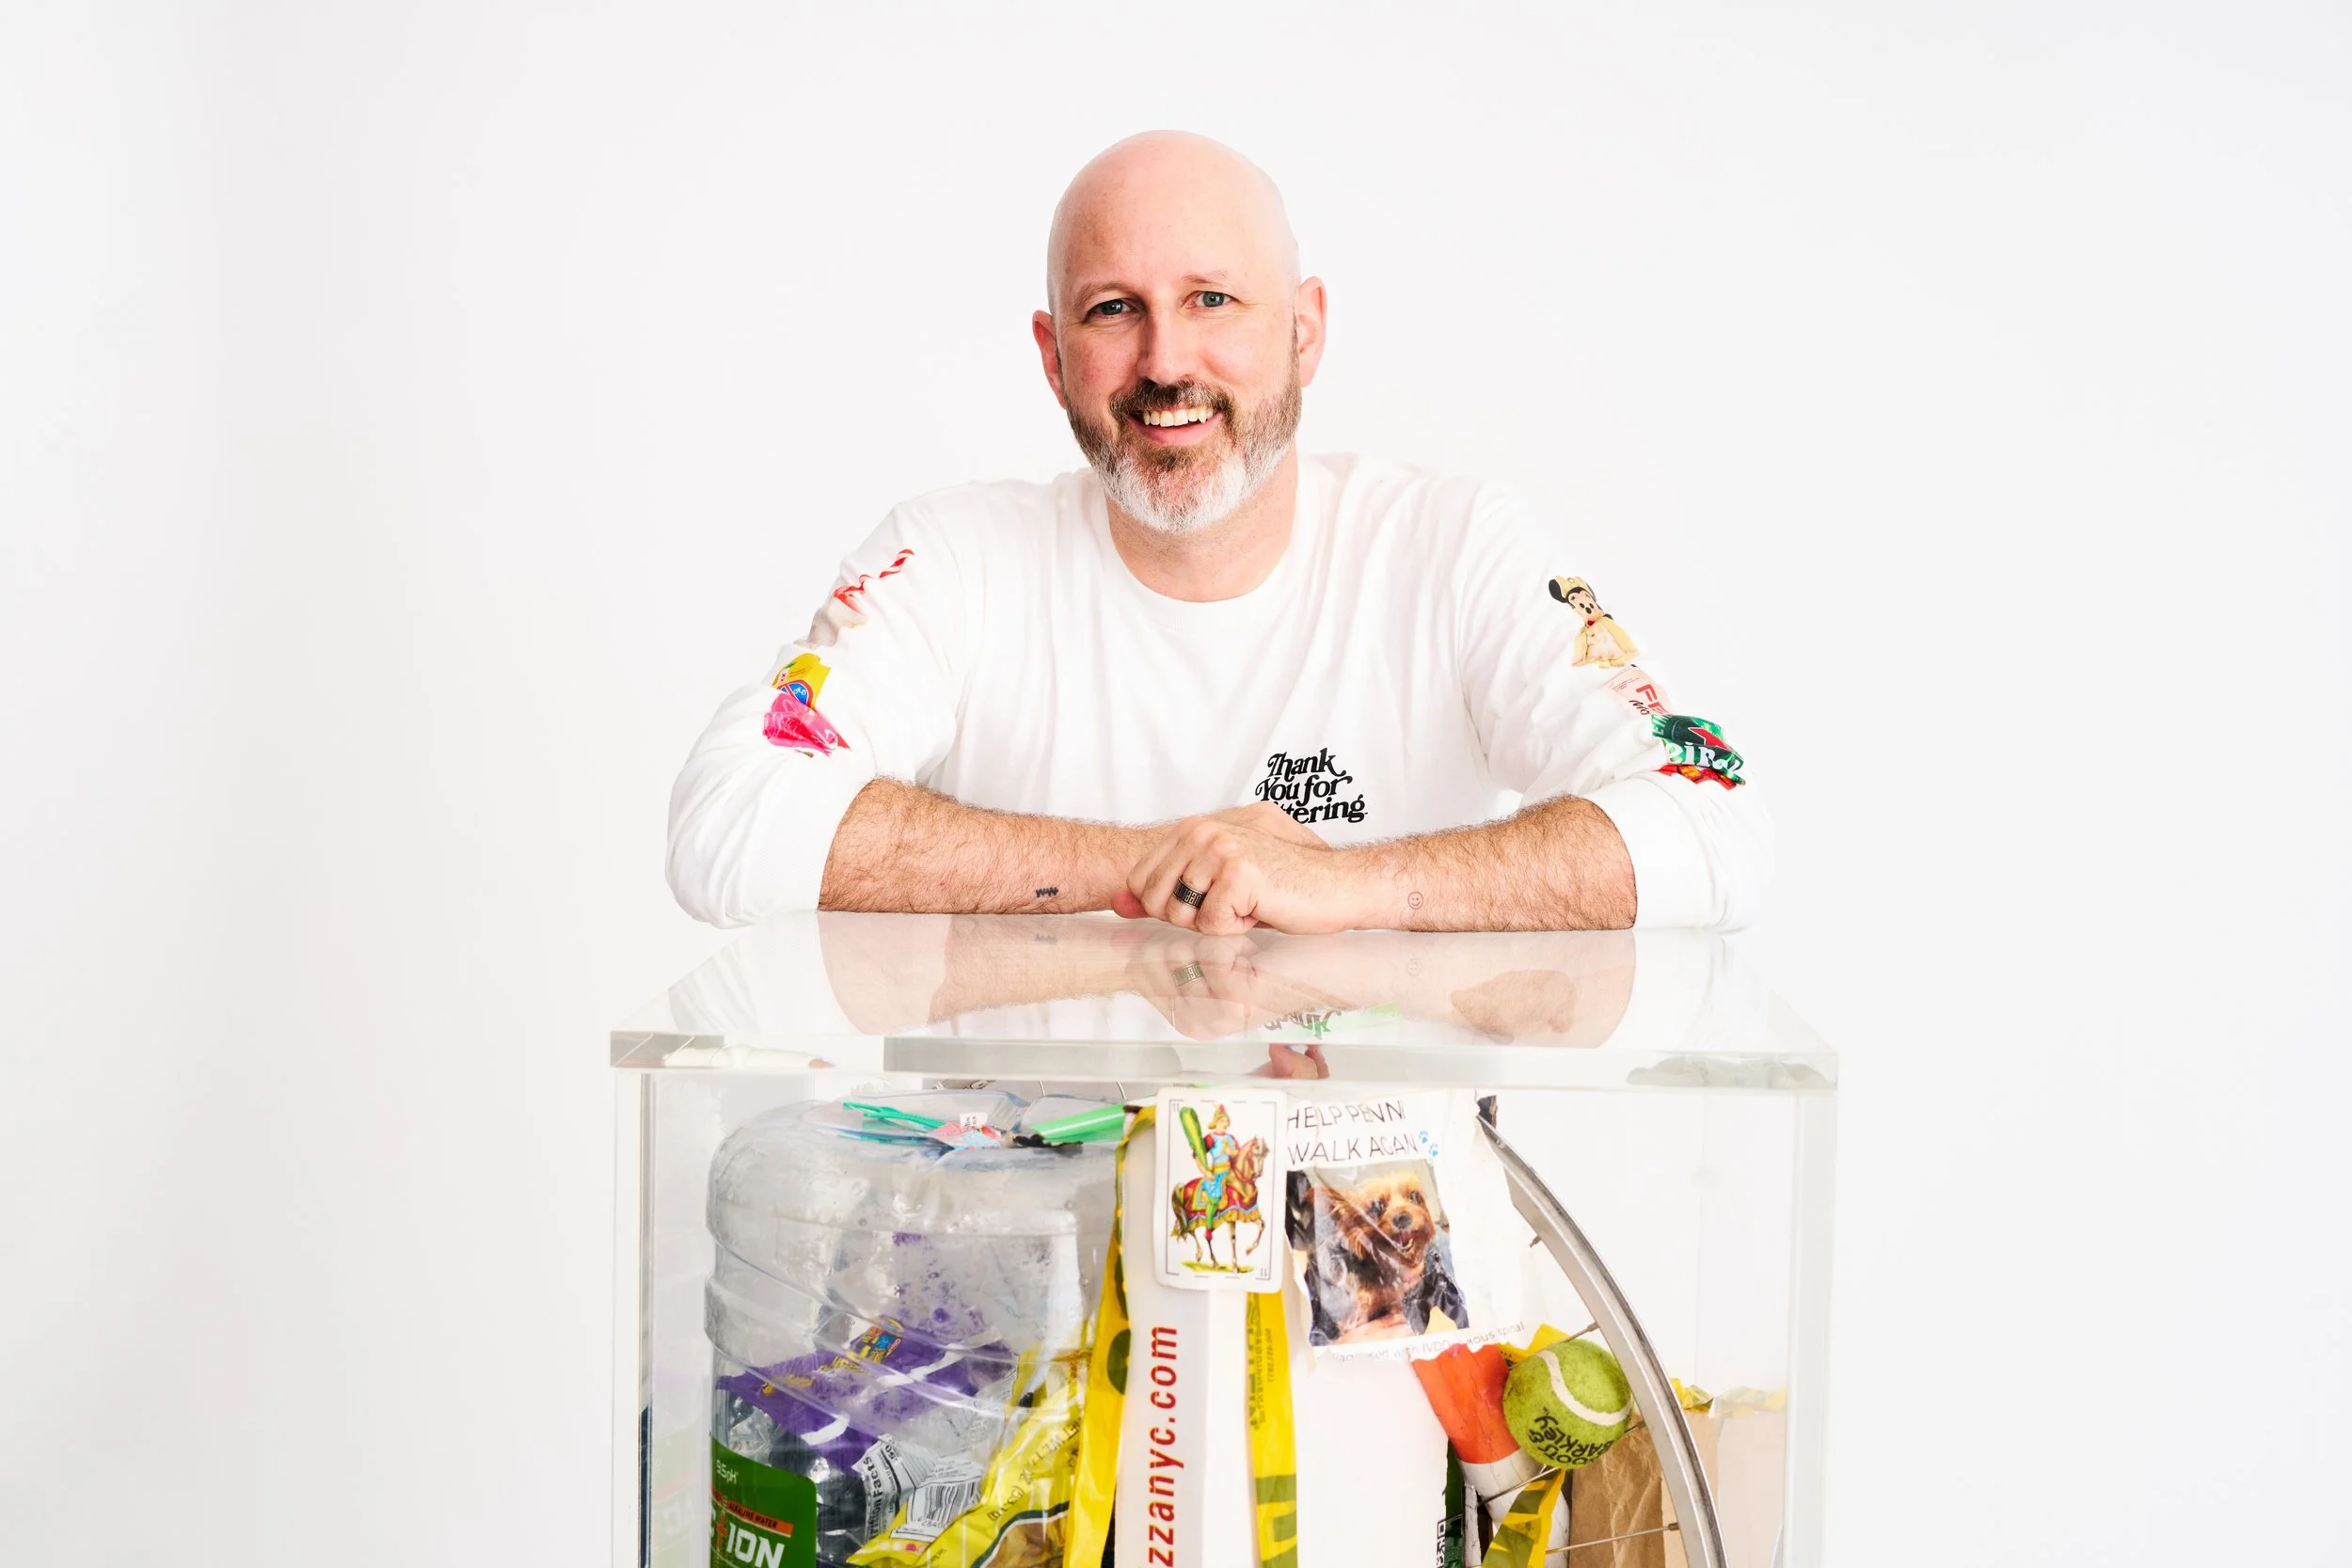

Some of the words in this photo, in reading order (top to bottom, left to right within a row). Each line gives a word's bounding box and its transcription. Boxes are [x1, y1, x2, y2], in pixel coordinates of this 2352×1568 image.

[1267, 747, 1346, 782] Thank
[1255, 777, 1300, 801] You
[1295, 774, 1353, 807] for
[1287, 1105, 1343, 1130] HELP
[1287, 1137, 1362, 1165] WALK
[1149, 1327, 1184, 1568] zzanyc.com
[863, 1456, 883, 1497] Facts
